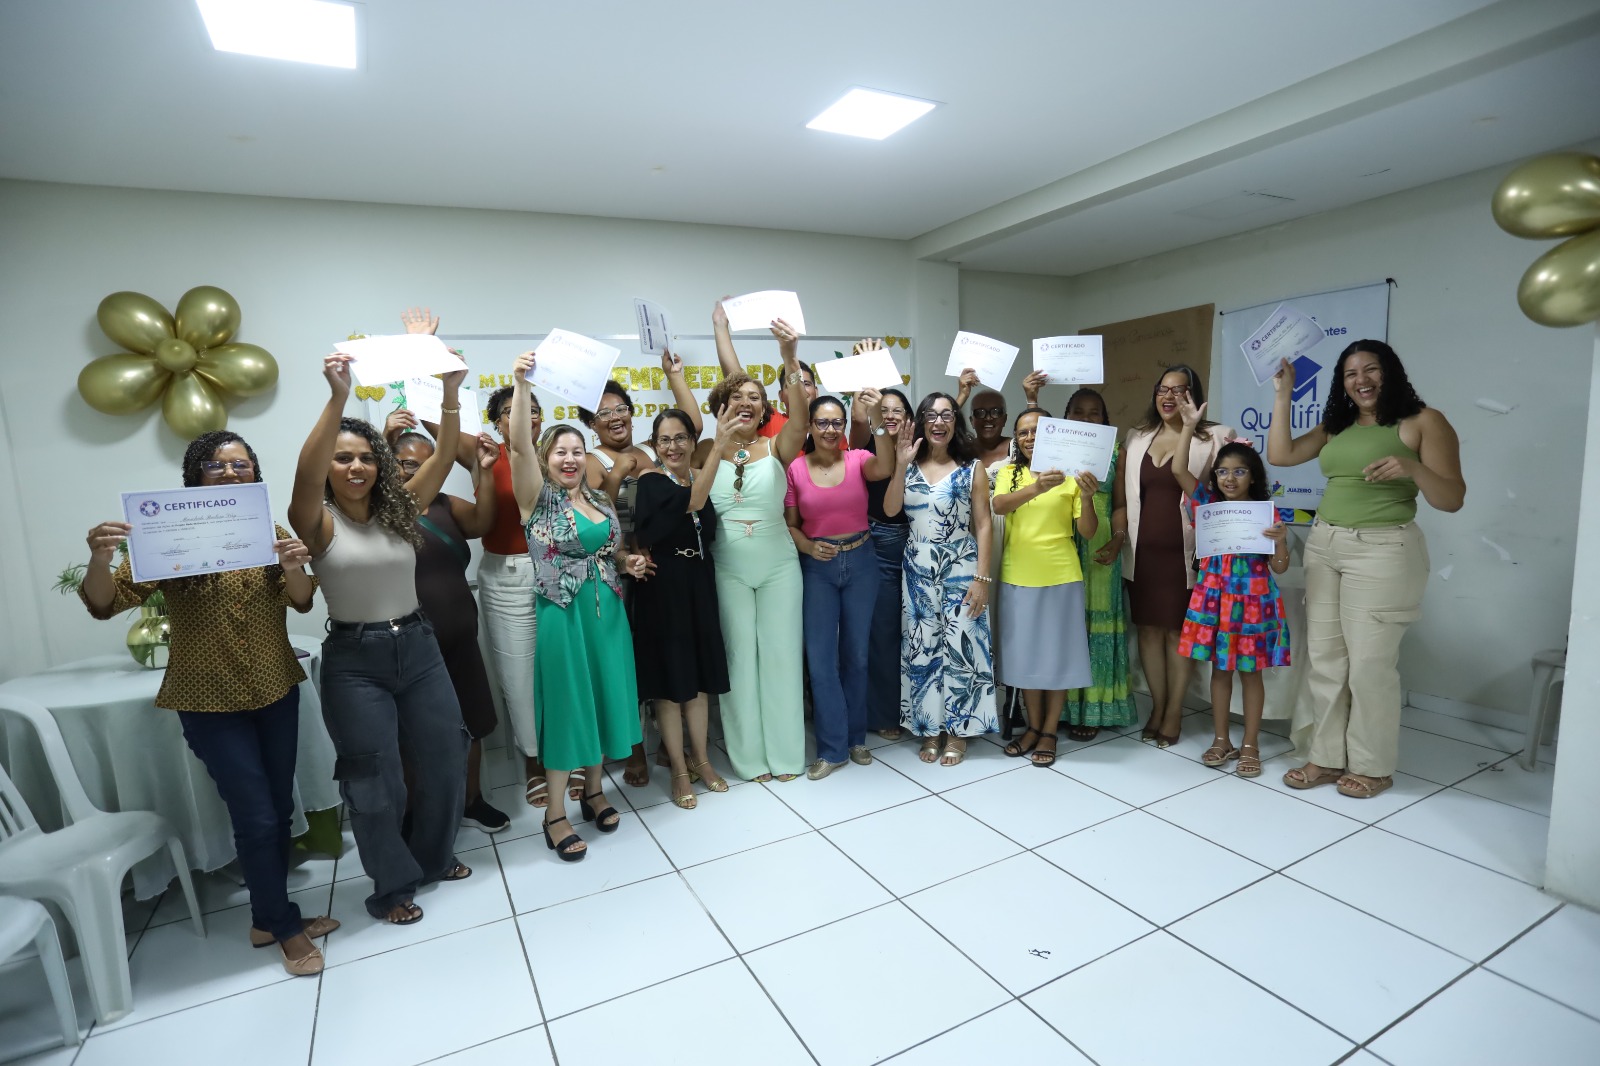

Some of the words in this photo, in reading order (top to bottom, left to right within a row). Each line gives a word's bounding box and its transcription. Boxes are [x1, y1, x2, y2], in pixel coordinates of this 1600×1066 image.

[1324, 327, 1347, 337] ntes
[1057, 427, 1097, 438] CERTIFICADO
[164, 498, 237, 512] CERTIFICADO
[1212, 509, 1252, 517] CERTIFICADO
